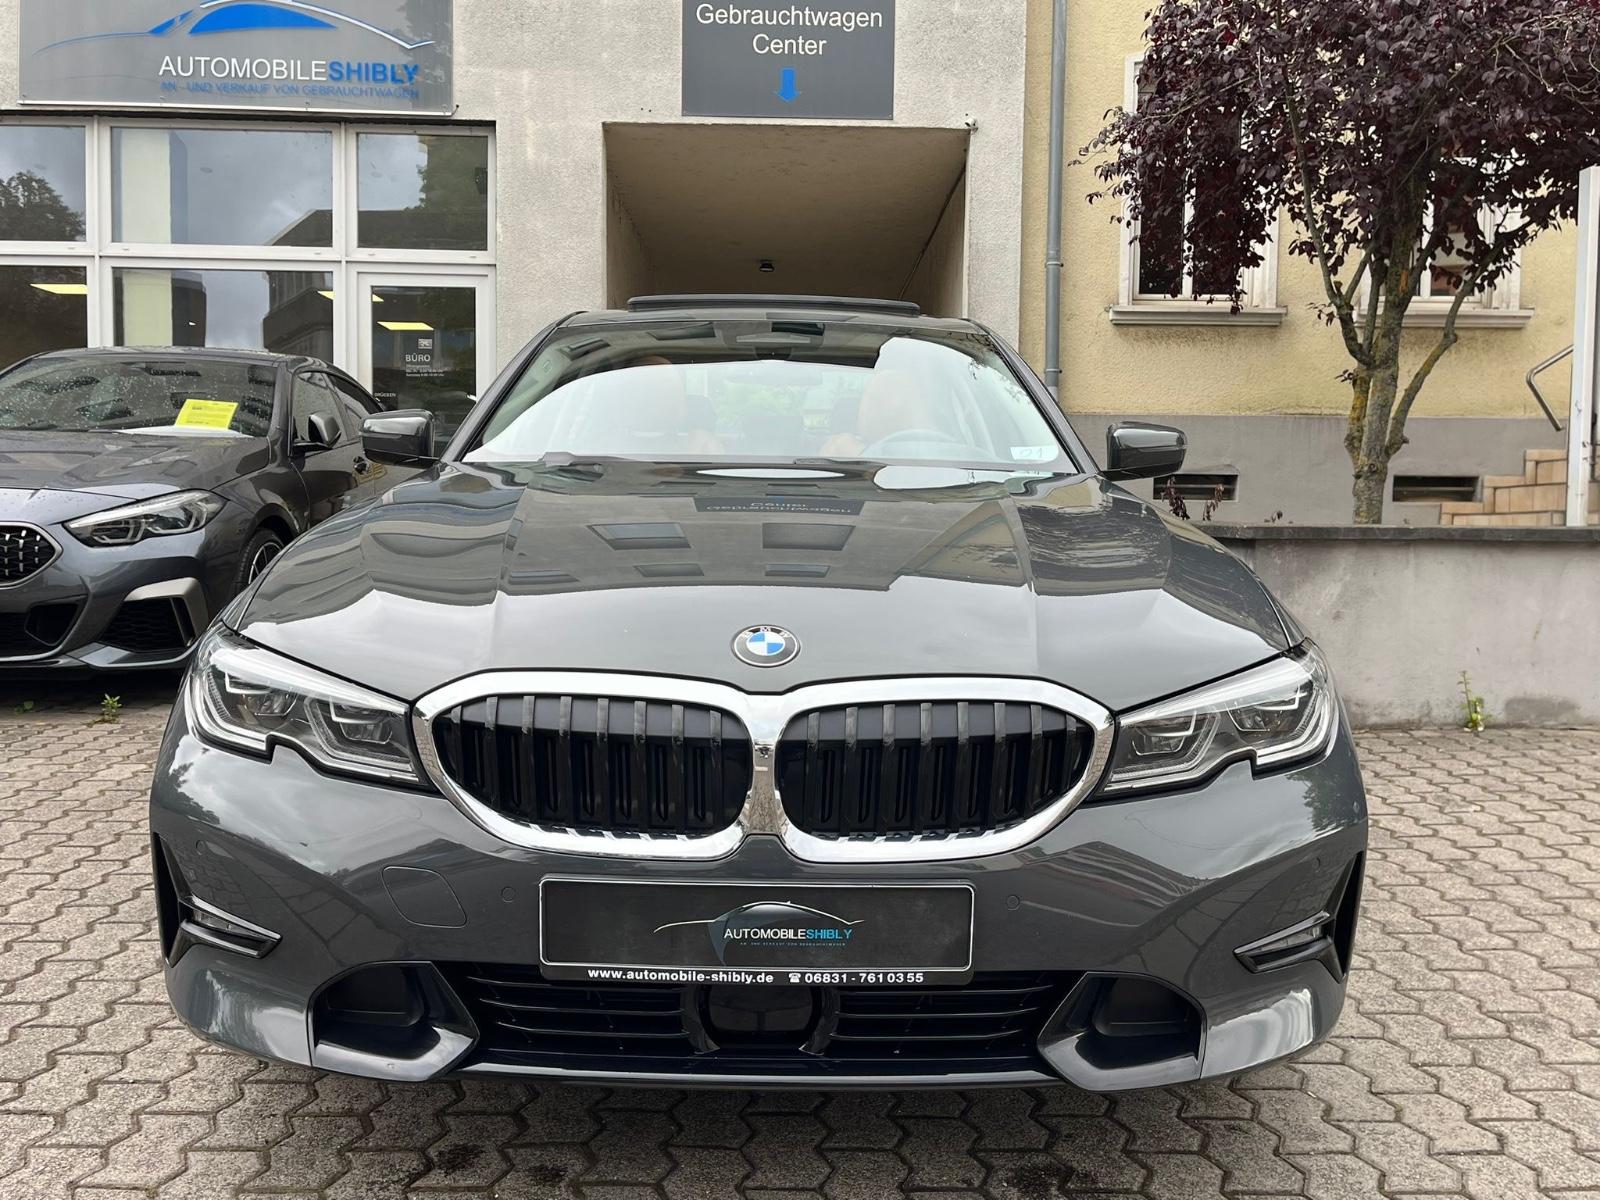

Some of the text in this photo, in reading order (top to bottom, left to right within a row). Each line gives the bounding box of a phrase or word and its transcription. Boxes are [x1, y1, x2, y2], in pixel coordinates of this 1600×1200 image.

[696, 4, 883, 32] Gebrauchtwagen
[752, 33, 827, 55] Center
[186, 82, 213, 93] UND
[215, 82, 272, 95] VERKAUF
[273, 84, 299, 95] VON
[302, 85, 419, 98] GEBRAUCHTWAGEN
[405, 353, 431, 362] BÜRO
[587, 968, 775, 984] www.automobile-shibly.de
[804, 973, 848, 984] 06831
